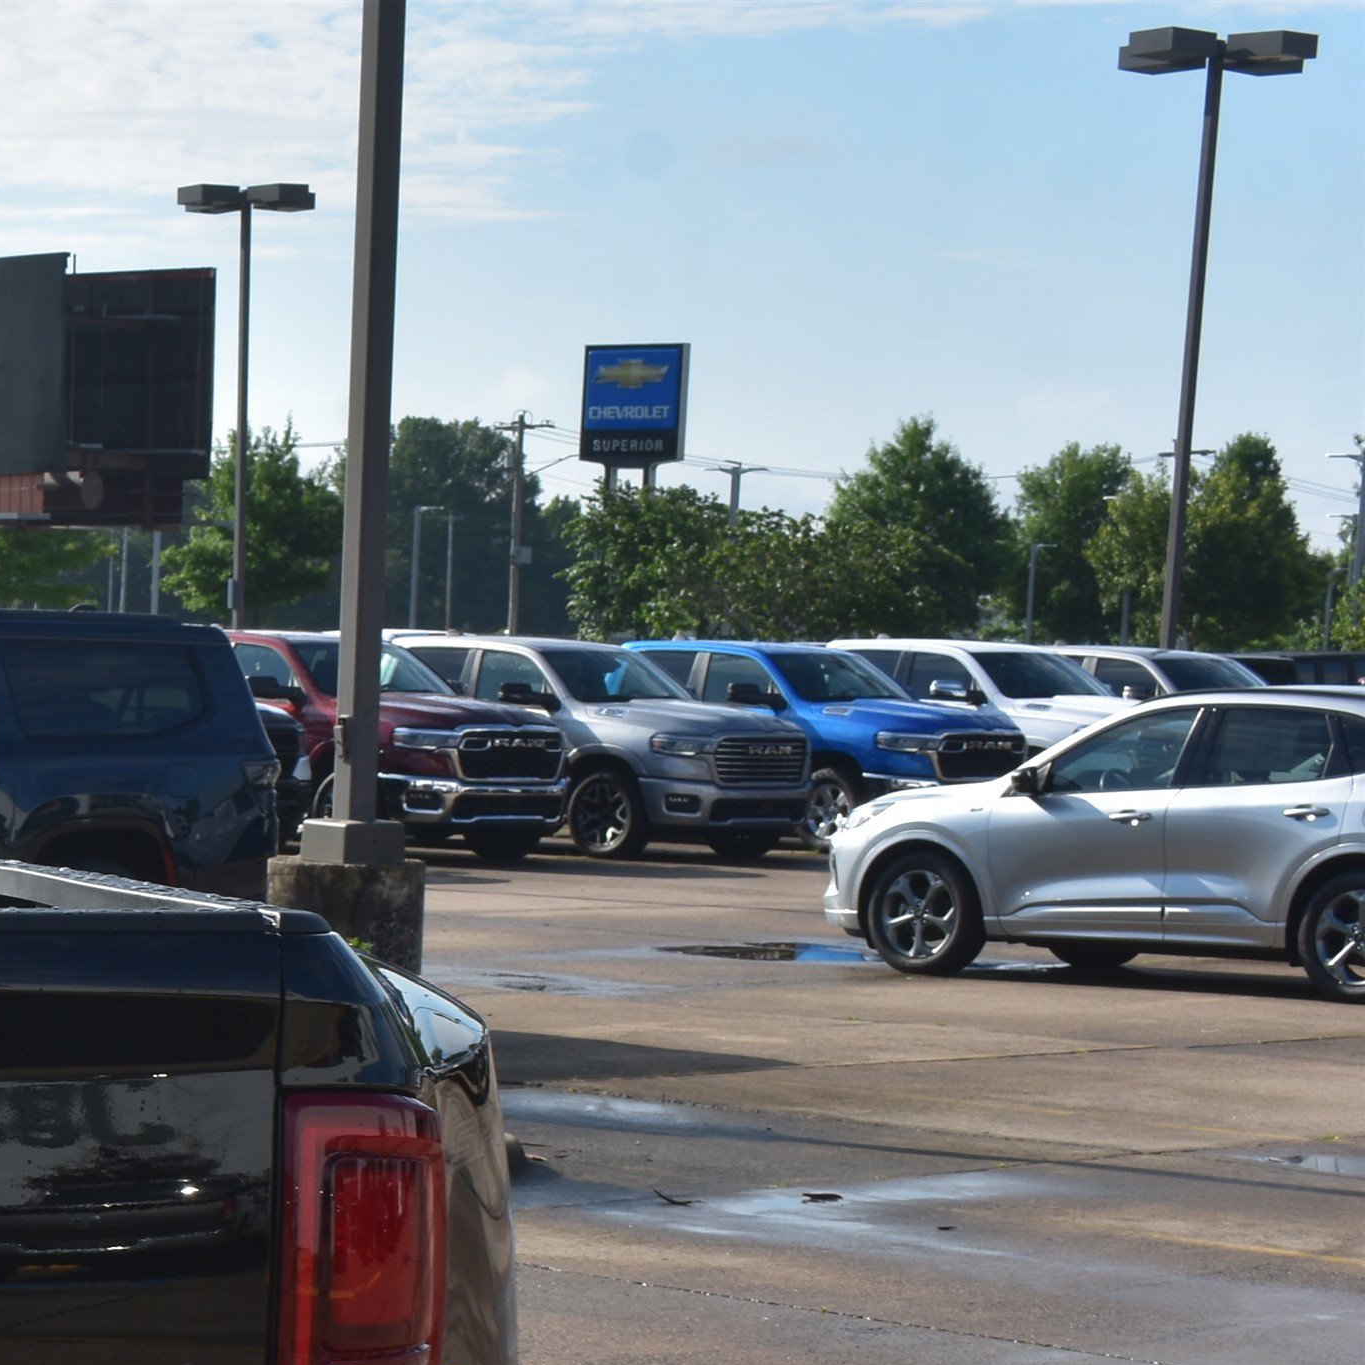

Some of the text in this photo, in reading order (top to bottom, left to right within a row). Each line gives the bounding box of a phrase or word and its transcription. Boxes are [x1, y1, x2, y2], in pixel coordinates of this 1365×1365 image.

[588, 405, 670, 420] CHEVROLET
[592, 438, 664, 452] SUPERIOR
[494, 738, 545, 748] RAM
[748, 745, 792, 755] RAM
